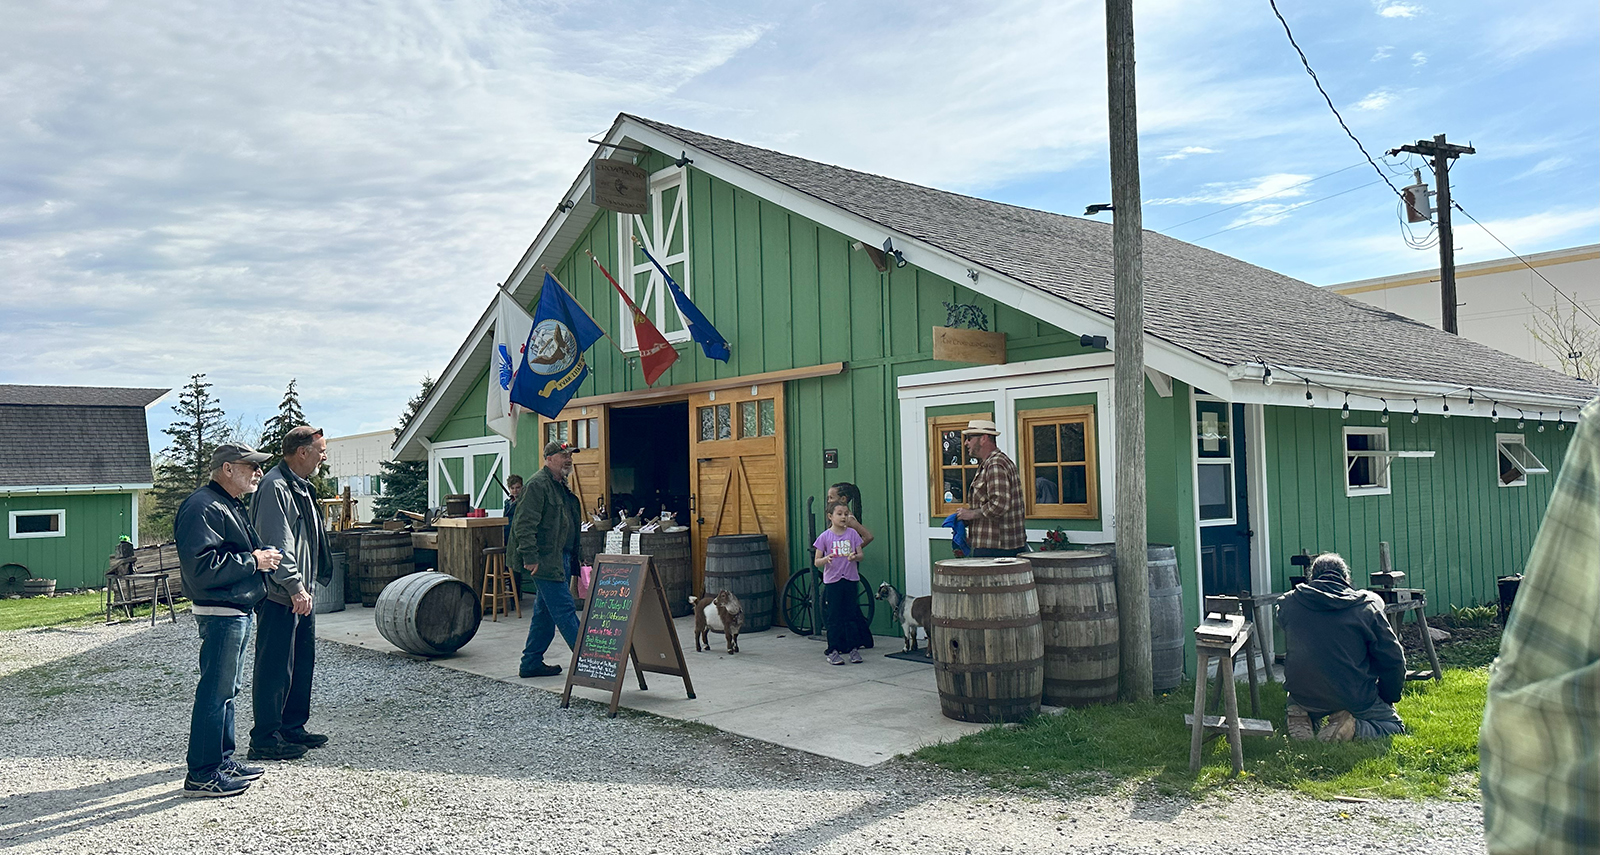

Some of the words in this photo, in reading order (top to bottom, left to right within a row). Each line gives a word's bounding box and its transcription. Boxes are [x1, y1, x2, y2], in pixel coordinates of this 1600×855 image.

[619, 587, 630, 597] $10
[622, 599, 632, 610] $10
[602, 620, 610, 628] $10
